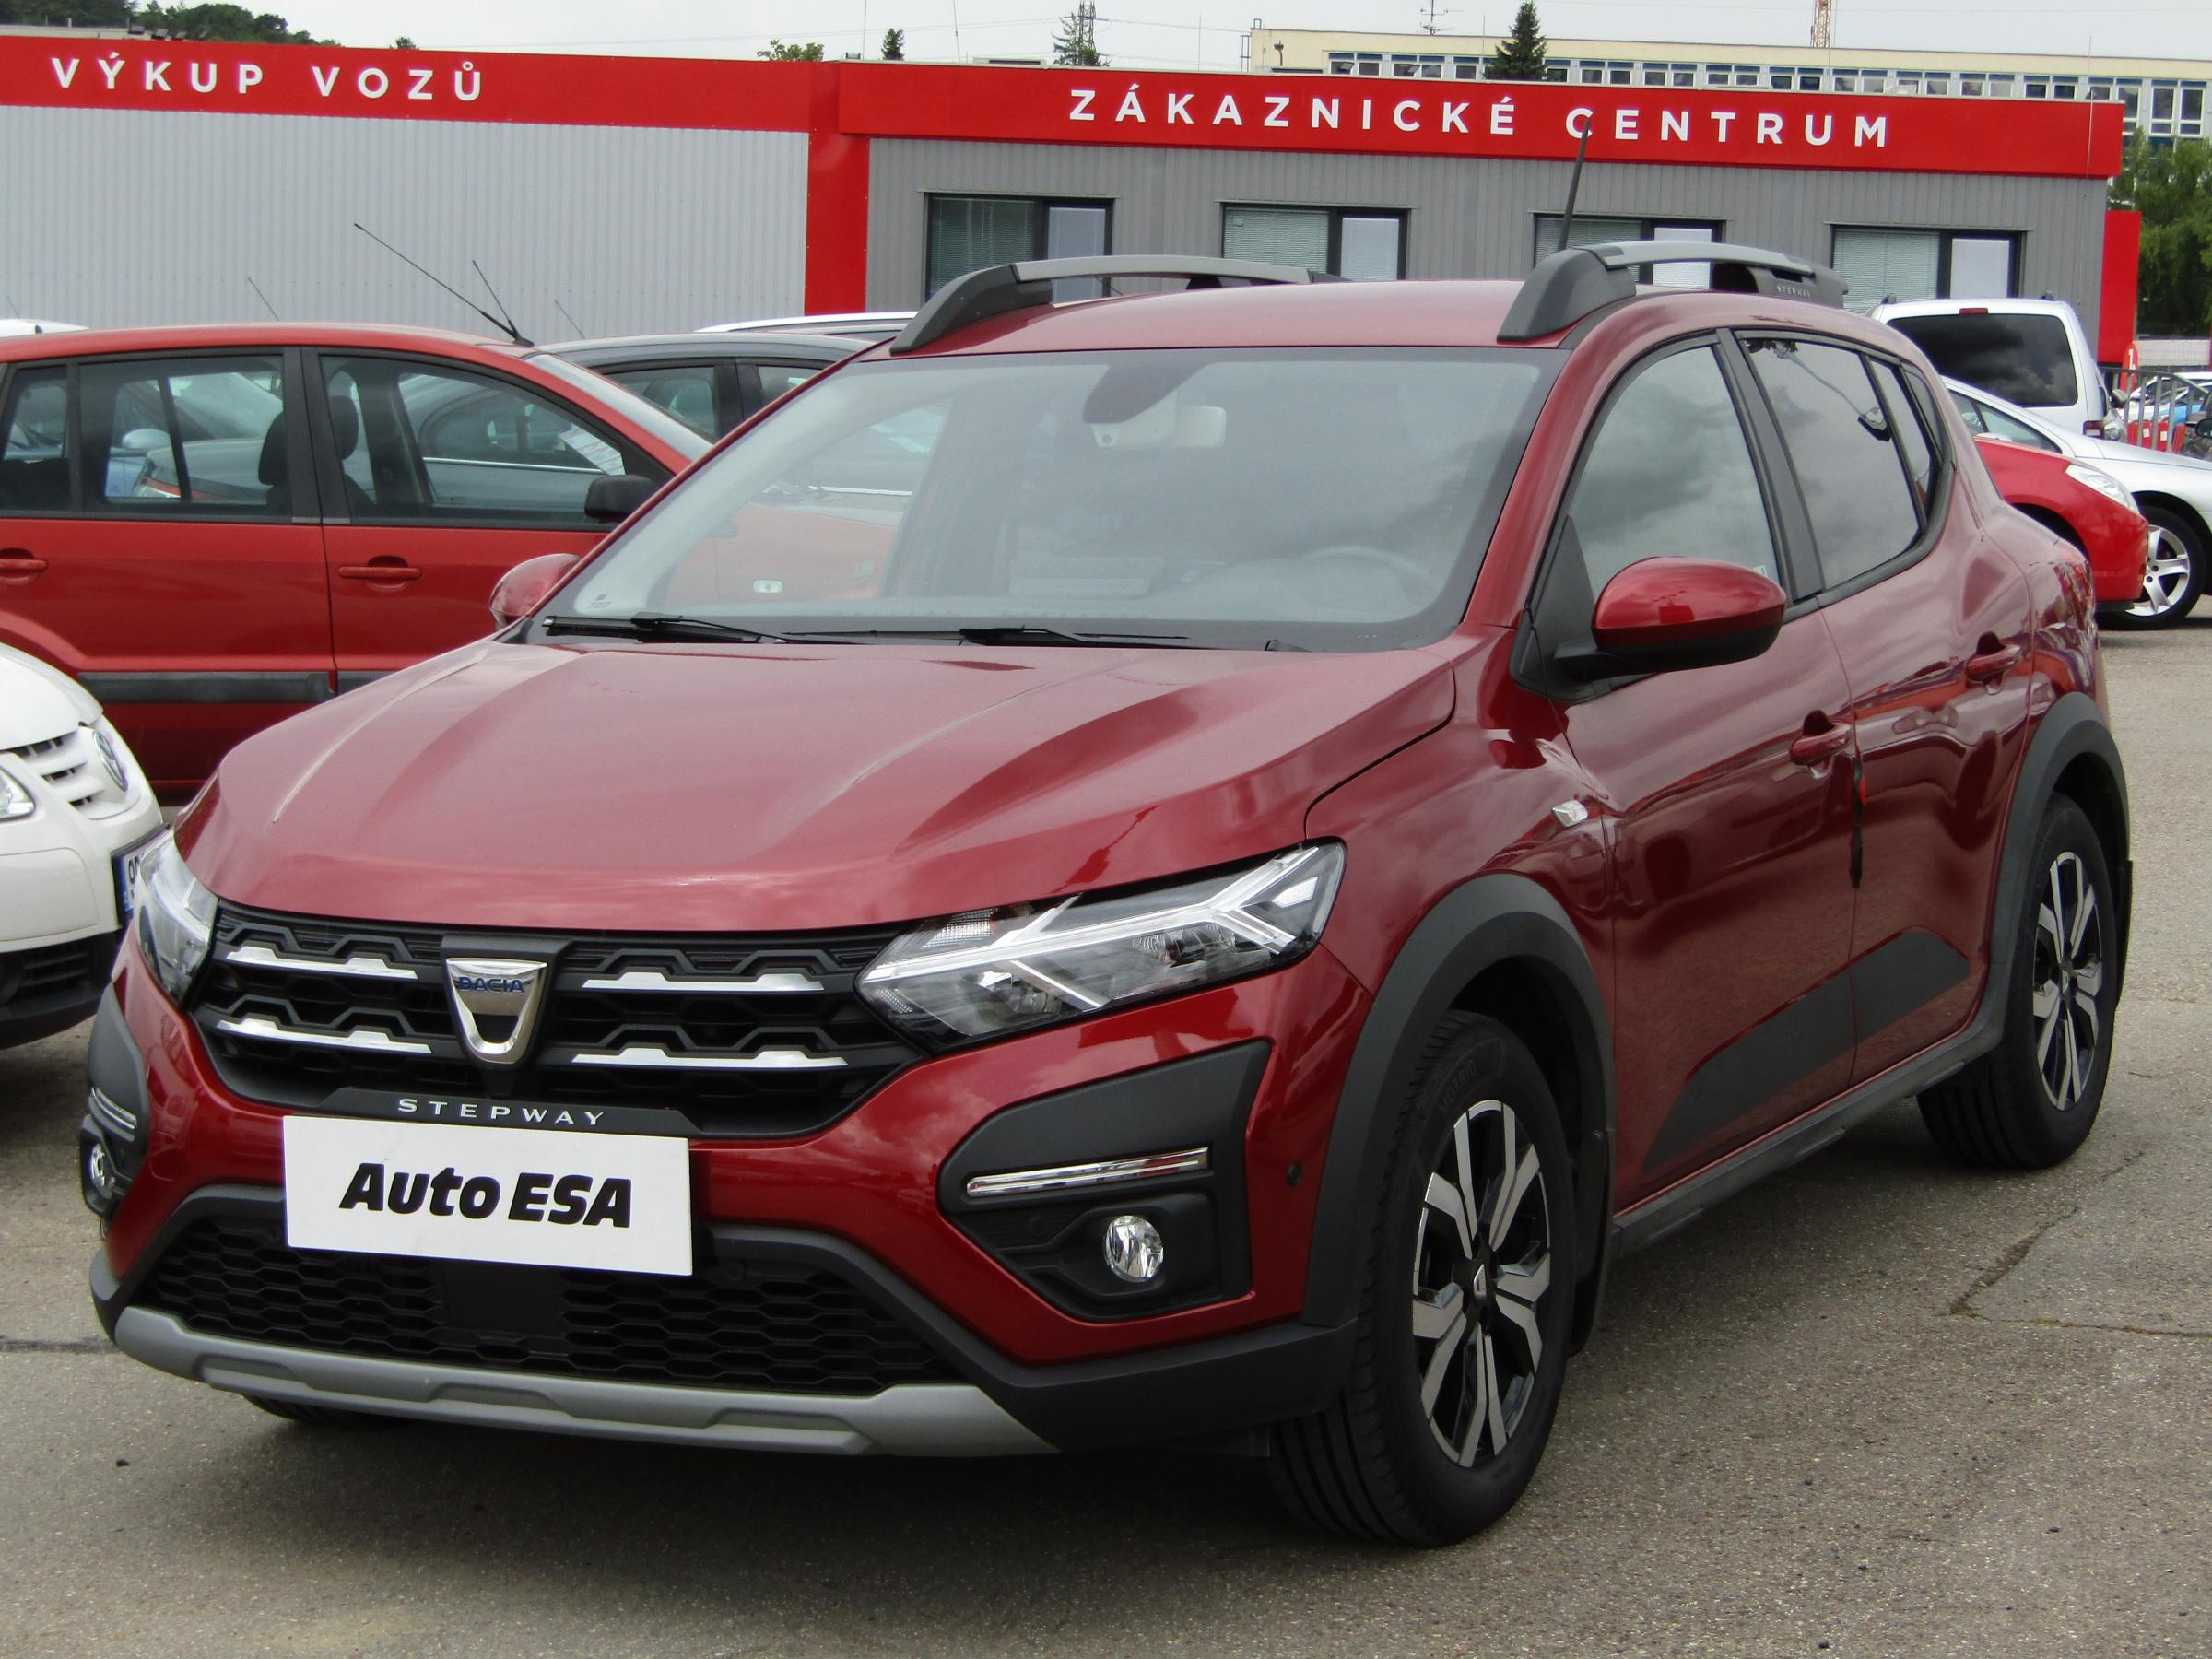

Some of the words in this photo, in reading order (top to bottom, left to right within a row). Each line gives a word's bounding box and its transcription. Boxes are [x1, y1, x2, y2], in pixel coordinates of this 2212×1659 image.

[52, 52, 264, 94] VÝKUP
[312, 61, 481, 101] VOZŮ
[1070, 83, 1516, 135] ZÁKAZNICKÉ
[1566, 108, 1887, 147] CENTRUM
[1776, 285, 1810, 297] STEPWAY
[459, 976, 525, 993] DACIA
[398, 1099, 604, 1125] STEPWAY
[338, 1162, 501, 1219] Auto
[508, 1172, 632, 1229] ESA
